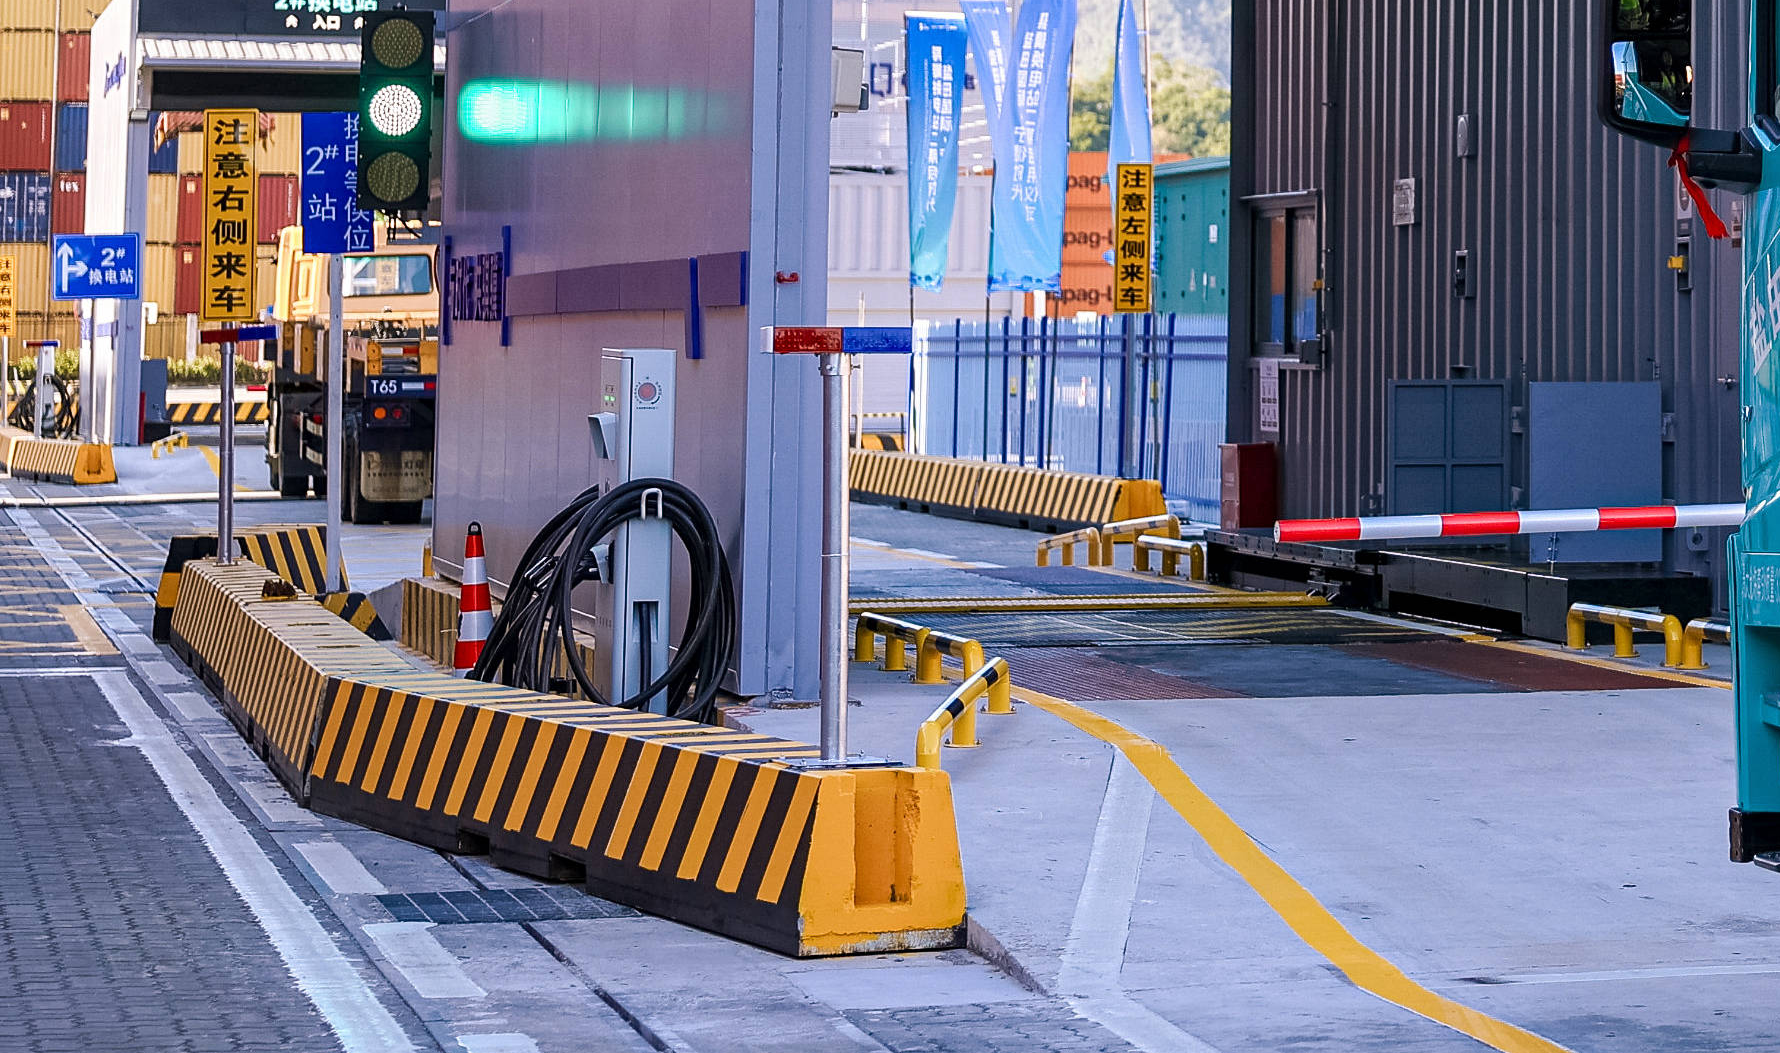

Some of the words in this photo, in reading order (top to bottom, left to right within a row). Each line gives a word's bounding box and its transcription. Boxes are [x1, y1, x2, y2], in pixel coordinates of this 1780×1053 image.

[312, 14, 341, 31] 入口
[210, 118, 250, 313] 注意右侧来车
[308, 192, 337, 222] 站
[1120, 169, 1147, 307] 注意左侧来车
[101, 247, 126, 268] 2#
[88, 267, 134, 286] 换电站
[370, 379, 398, 395] T65
